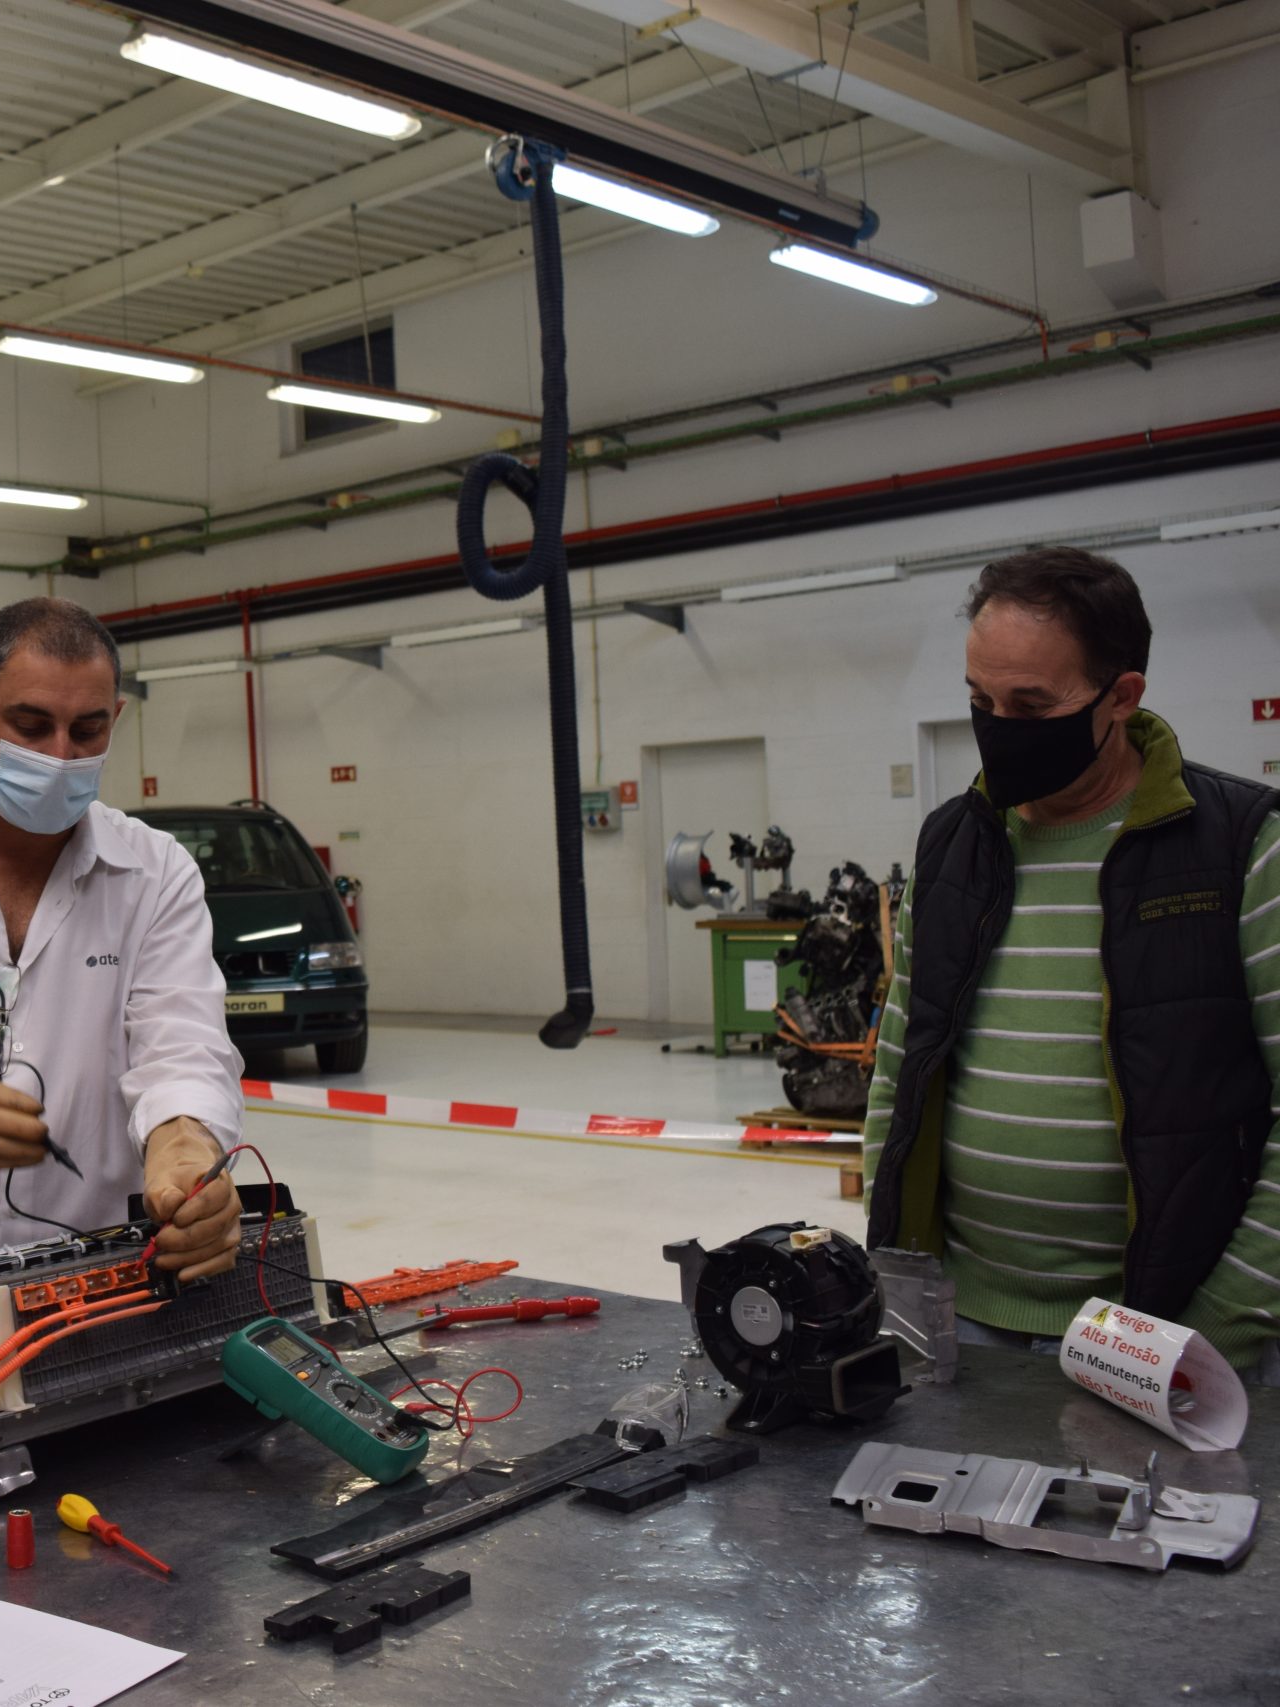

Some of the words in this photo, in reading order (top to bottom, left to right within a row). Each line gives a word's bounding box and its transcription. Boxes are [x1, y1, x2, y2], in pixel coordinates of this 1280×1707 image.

[1113, 1310, 1155, 1334] Perigo
[1079, 1326, 1108, 1345] Alta
[1111, 1336, 1161, 1366] Tensão
[1067, 1346, 1084, 1363] Em
[1087, 1353, 1160, 1393] Manutenção
[1074, 1371, 1103, 1393] Não
[1104, 1384, 1157, 1417] Tocar!!
